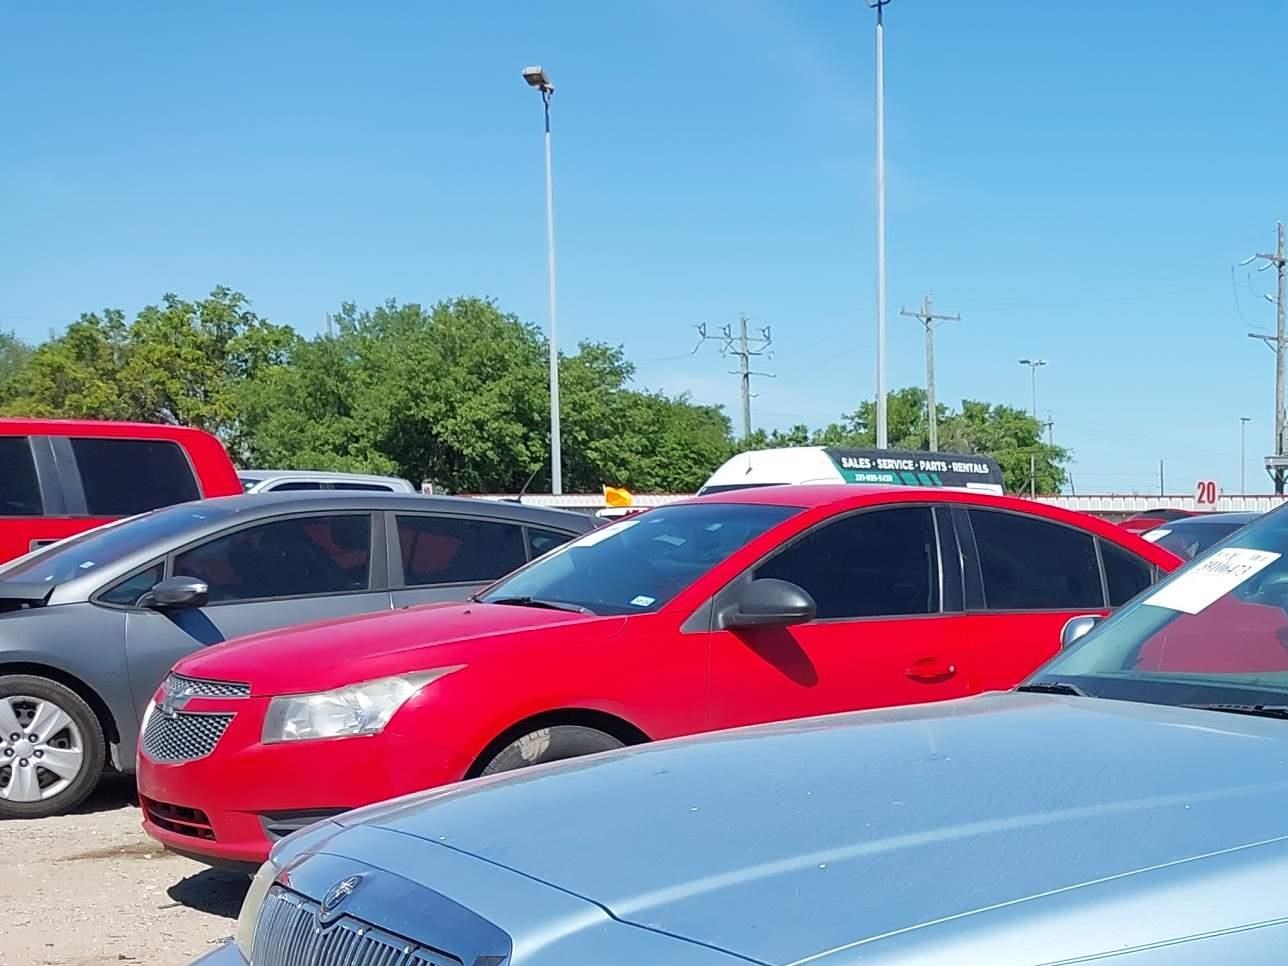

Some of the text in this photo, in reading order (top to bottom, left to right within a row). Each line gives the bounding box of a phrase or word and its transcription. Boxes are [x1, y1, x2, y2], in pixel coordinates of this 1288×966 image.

[841, 457, 989, 474] SALES SERVICE PARTS RENTALS
[1197, 481, 1216, 504] 20
